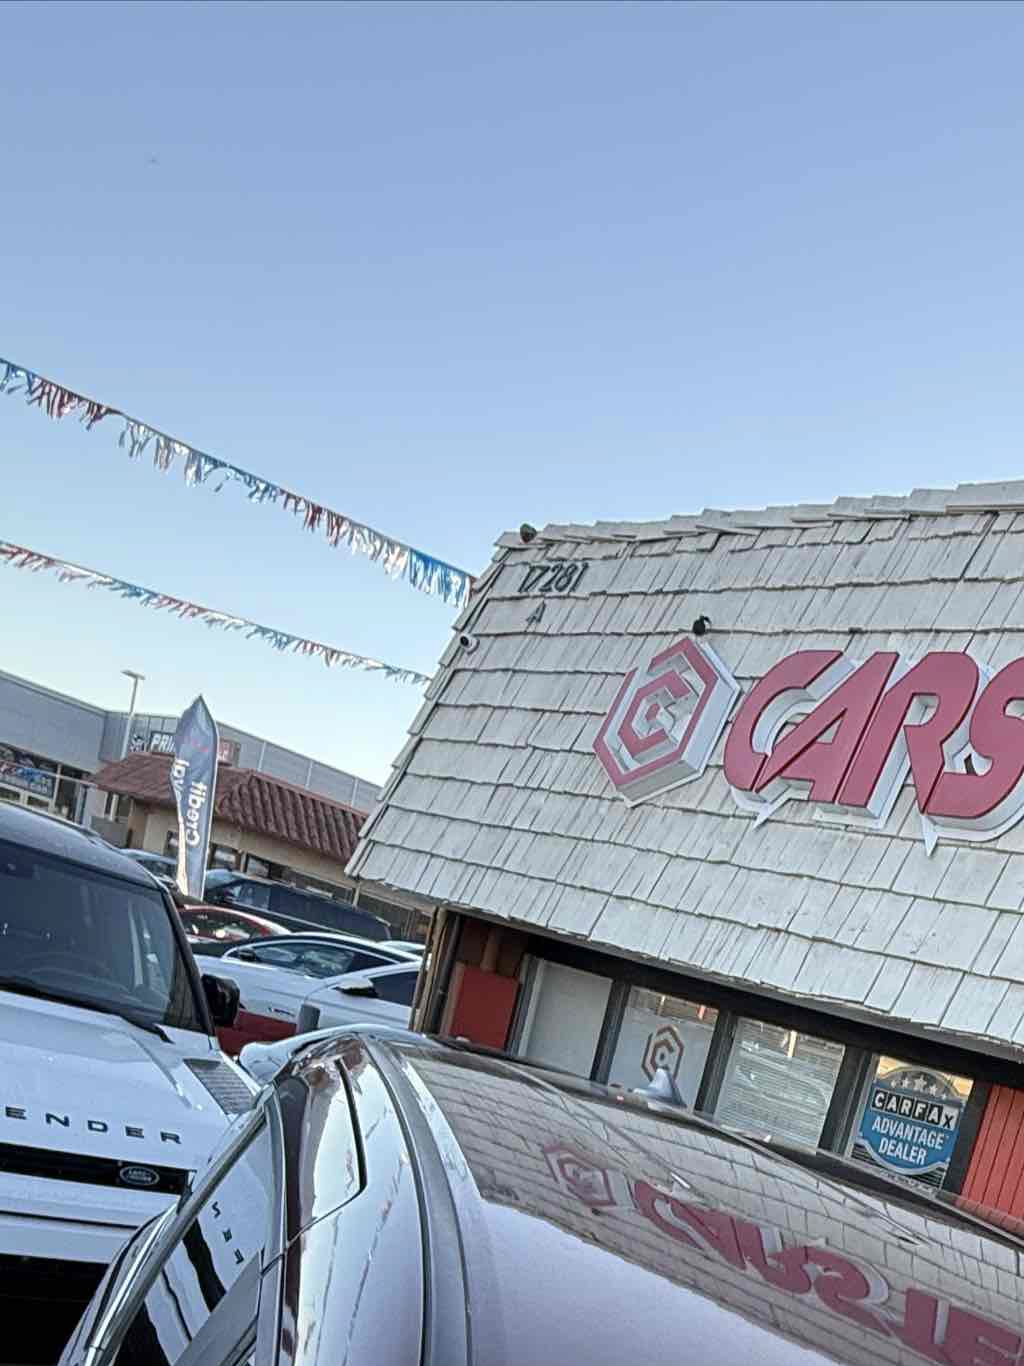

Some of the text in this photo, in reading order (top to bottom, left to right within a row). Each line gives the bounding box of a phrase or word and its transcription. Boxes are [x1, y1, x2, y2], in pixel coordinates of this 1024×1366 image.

[517, 562, 589, 593] 17281
[873, 1090, 956, 1131] CARFAX
[872, 1117, 945, 1149] ADVANTAGE
[878, 1138, 927, 1166] DEALER
